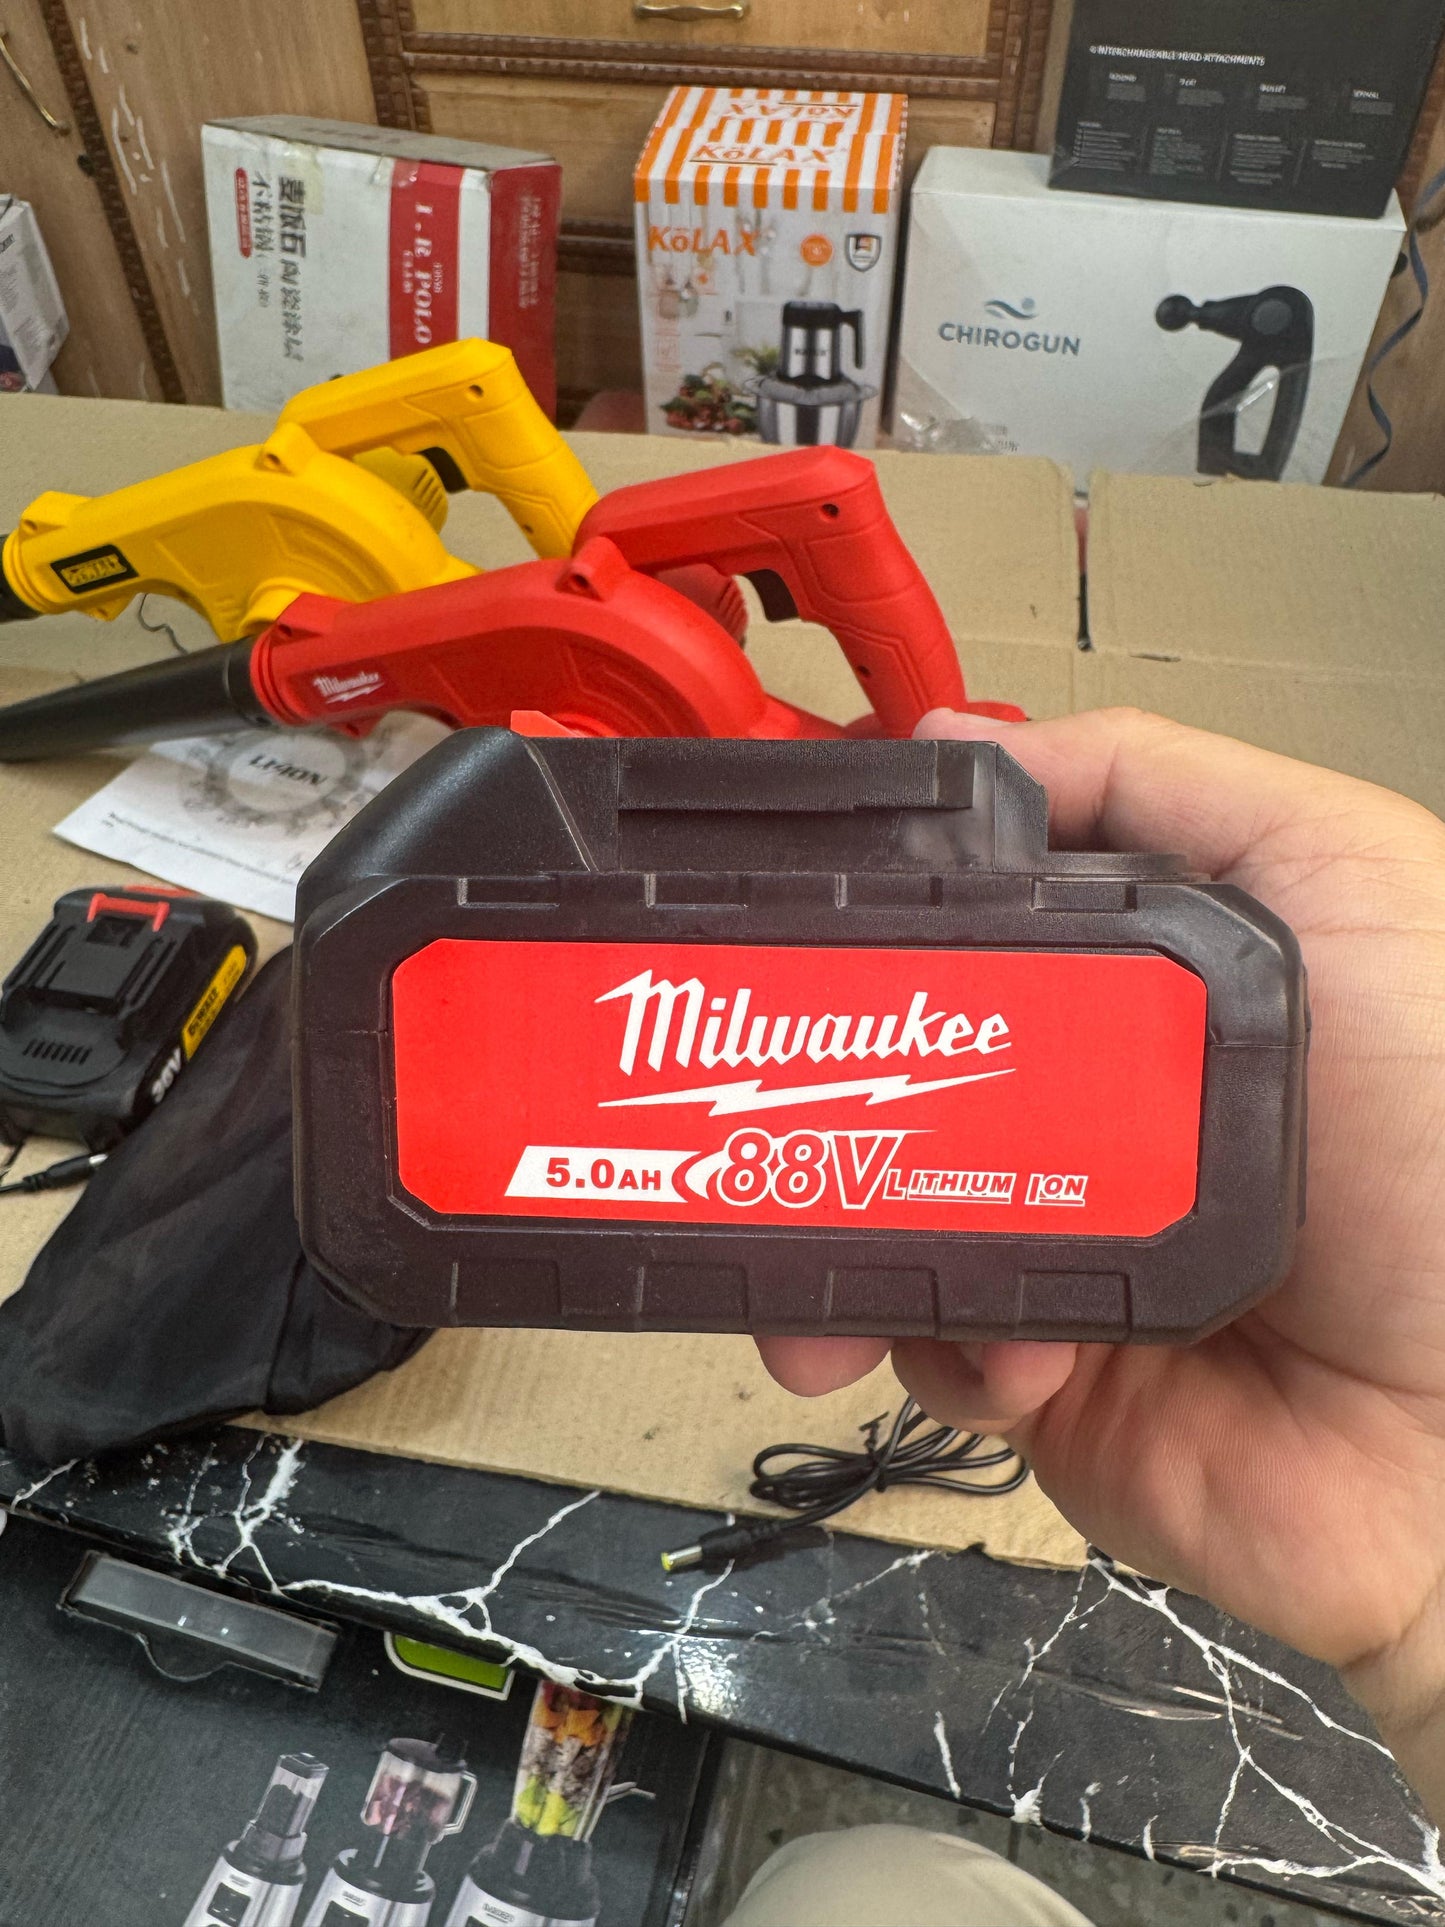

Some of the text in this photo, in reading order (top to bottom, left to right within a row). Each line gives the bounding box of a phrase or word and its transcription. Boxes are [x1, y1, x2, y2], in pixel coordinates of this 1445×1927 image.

[412, 269, 434, 345] POLO
[938, 321, 1081, 357] CHIROGUN
[594, 968, 1013, 1077] Milwaukee
[545, 1127, 1089, 1210] 5.0AH 88V LITHIUM ION
